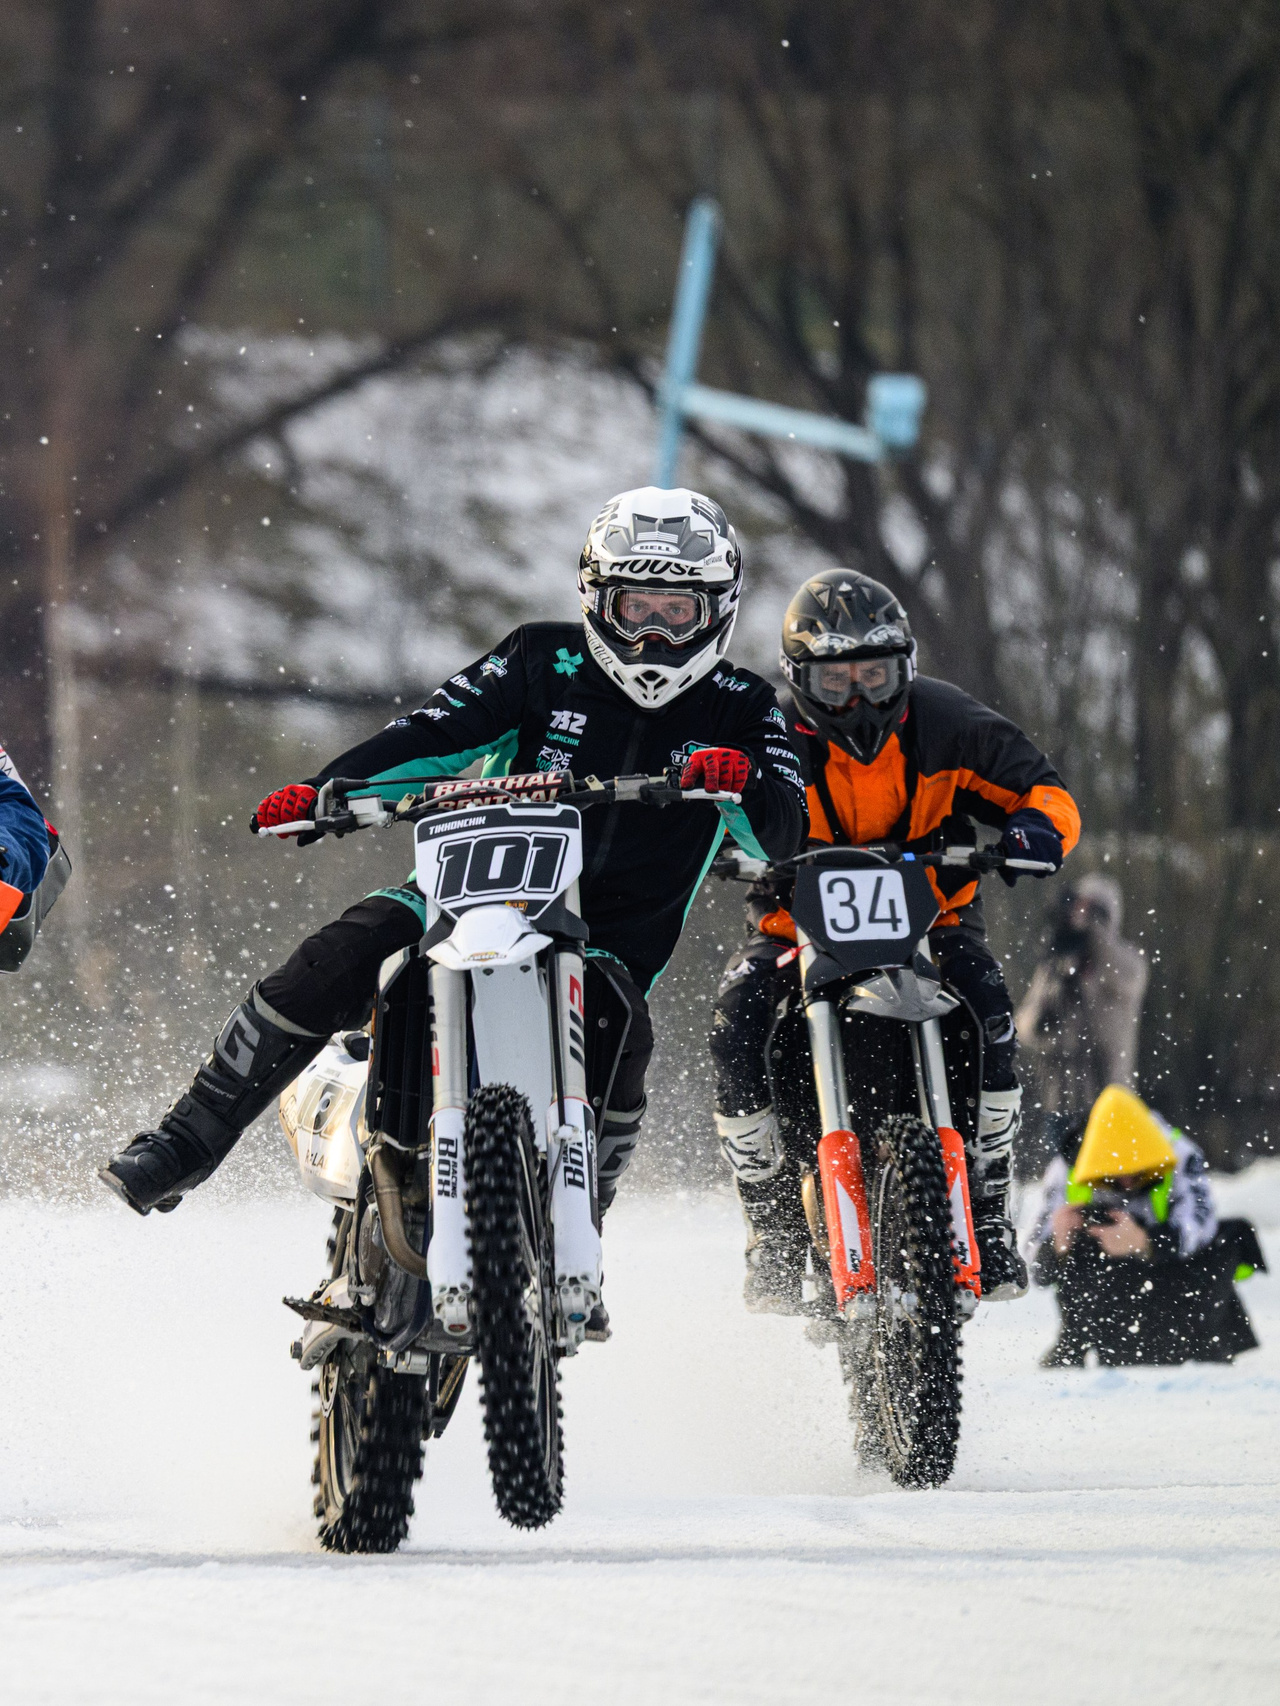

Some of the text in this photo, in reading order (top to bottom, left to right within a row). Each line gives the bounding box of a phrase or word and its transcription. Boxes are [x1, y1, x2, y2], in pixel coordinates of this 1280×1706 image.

[608, 558, 704, 577] HOUSE
[433, 772, 563, 798] RENTHAL
[437, 787, 559, 810] RENTAL
[428, 815, 487, 836] TIKHONCHIK
[434, 831, 570, 905] 101
[826, 876, 902, 934] 34
[450, 1161, 458, 1198] RACING
